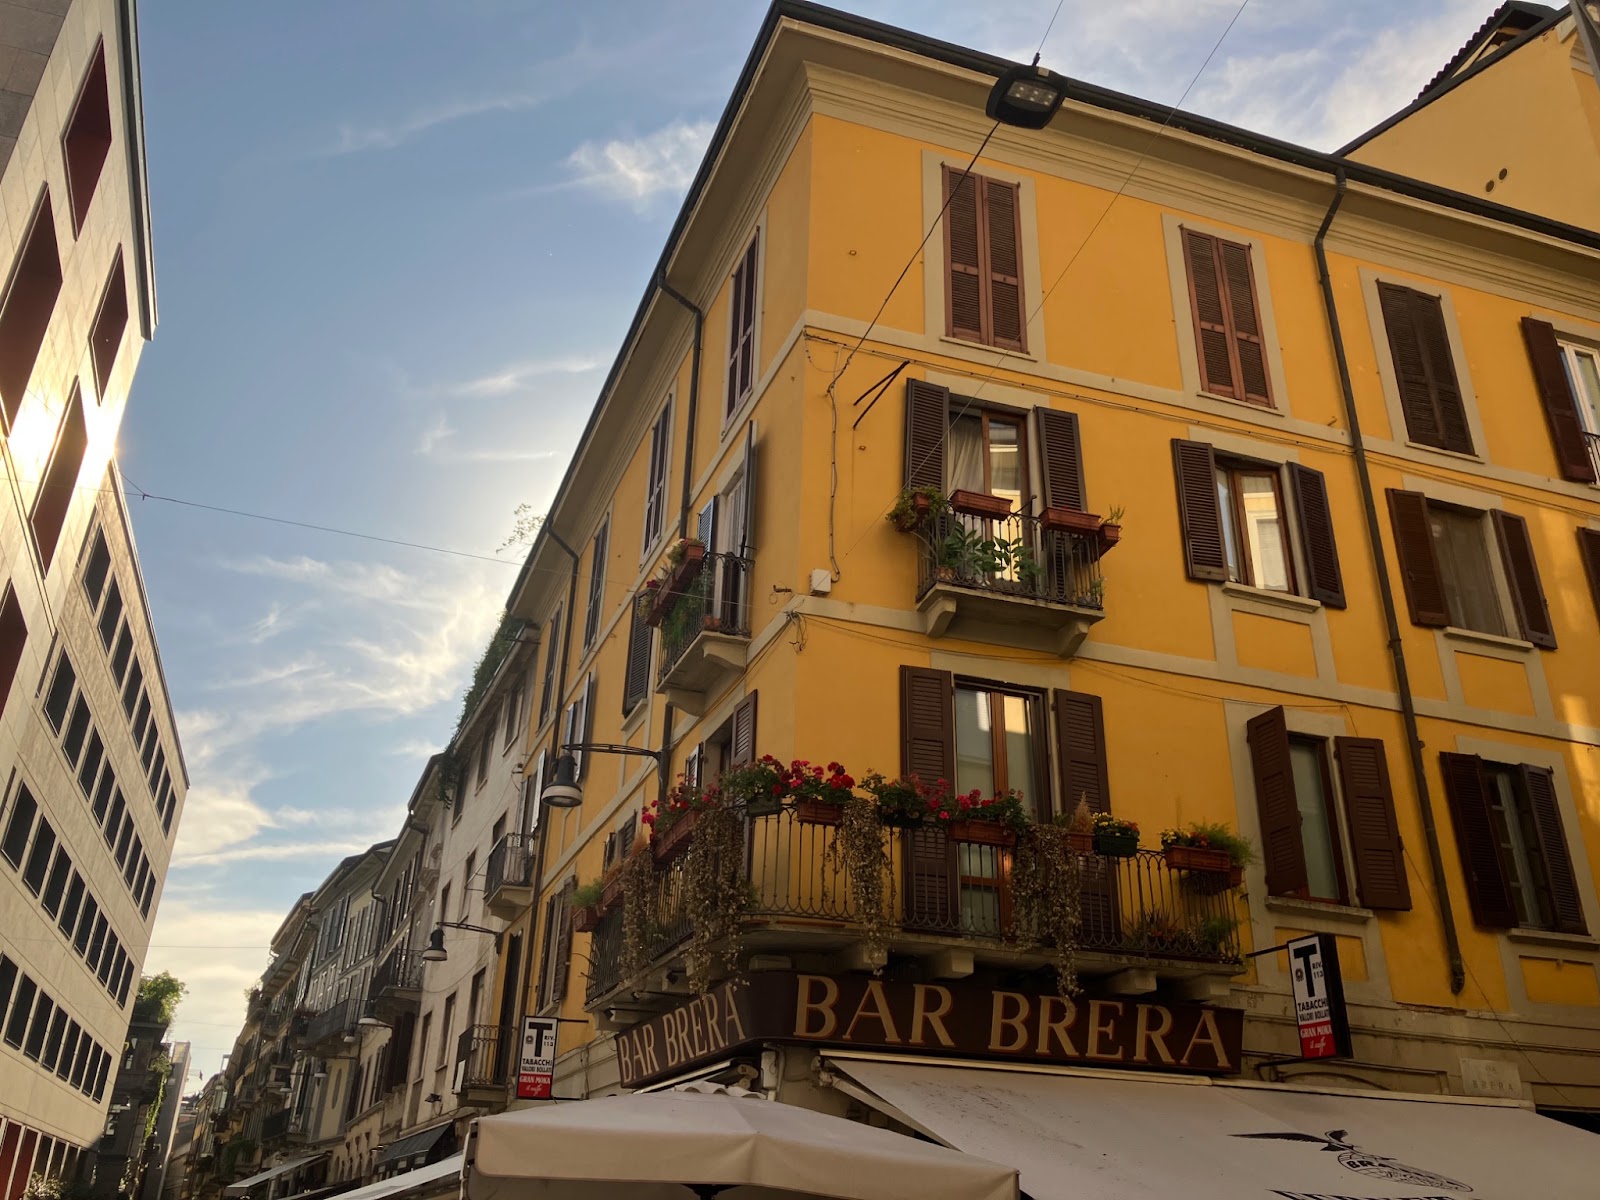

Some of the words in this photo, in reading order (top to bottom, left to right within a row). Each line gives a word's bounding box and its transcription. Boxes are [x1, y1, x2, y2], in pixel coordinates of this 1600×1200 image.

[1293, 943, 1317, 998] T
[1298, 999, 1329, 1011] TABACCHI
[618, 1023, 660, 1083] BAR
[662, 983, 746, 1068] BRERA
[793, 974, 955, 1047] BAR
[988, 990, 1232, 1069] BRERA
[1300, 1027, 1317, 1039] GRAN
[529, 1022, 553, 1057] T
[519, 1075, 535, 1083] GRAN
[1472, 1080, 1514, 1091] BRERA
